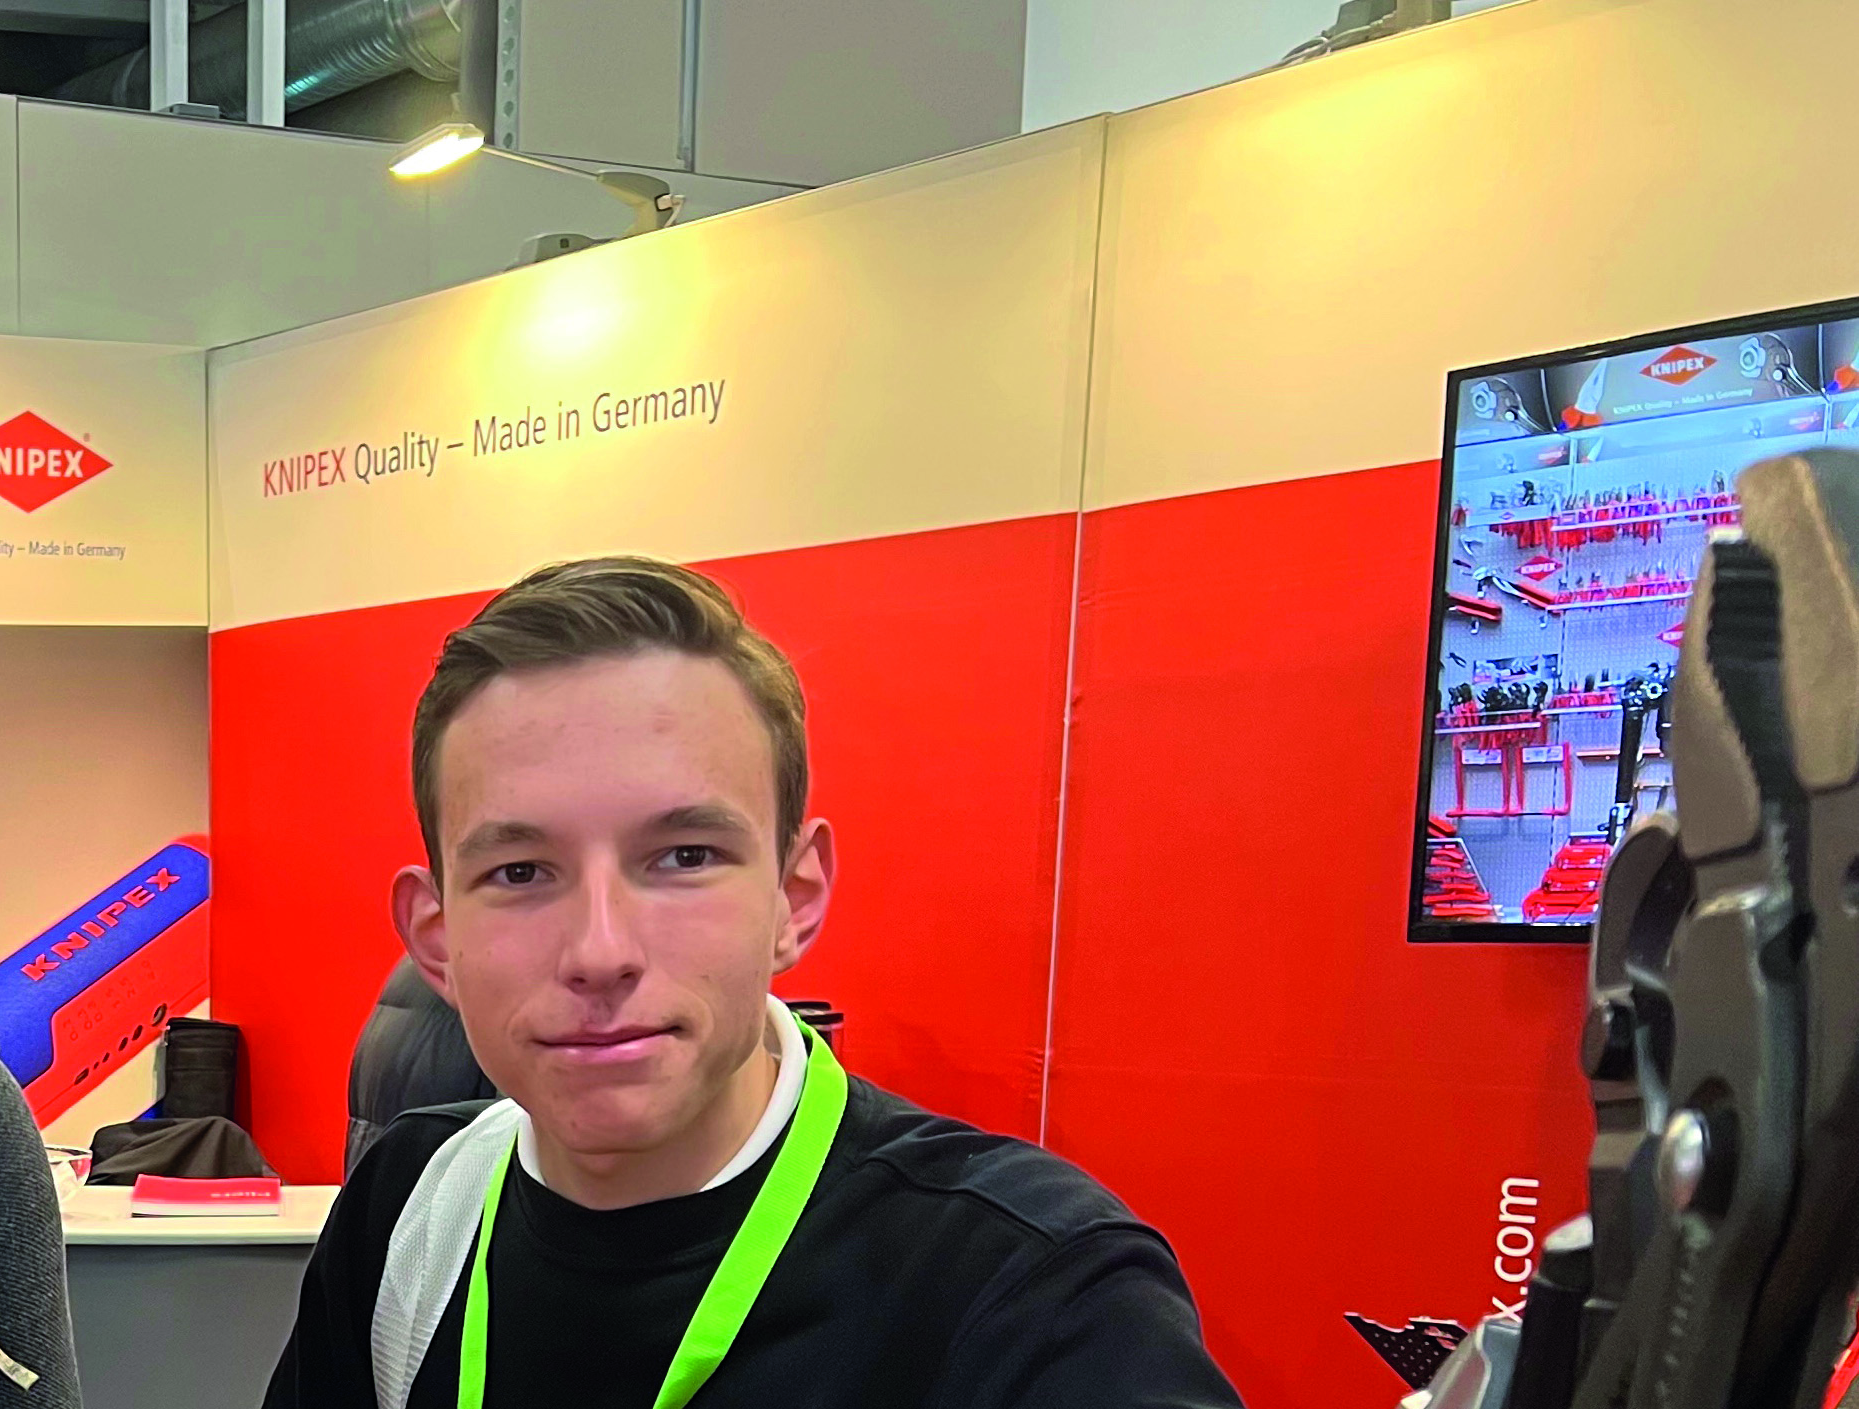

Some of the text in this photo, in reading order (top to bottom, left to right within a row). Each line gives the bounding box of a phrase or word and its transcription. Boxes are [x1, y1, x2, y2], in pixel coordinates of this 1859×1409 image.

[1650, 356, 1705, 377] KNIPEX
[262, 446, 347, 498] KNIPEX
[354, 431, 439, 485] Quality
[473, 405, 546, 457] Made
[557, 401, 580, 441] in
[592, 378, 726, 433] Germany
[29, 541, 60, 556] Made
[63, 542, 74, 556] in
[77, 542, 126, 561] Germany
[20, 867, 181, 982] KNIPEX
[1483, 1177, 1540, 1324] x.com
